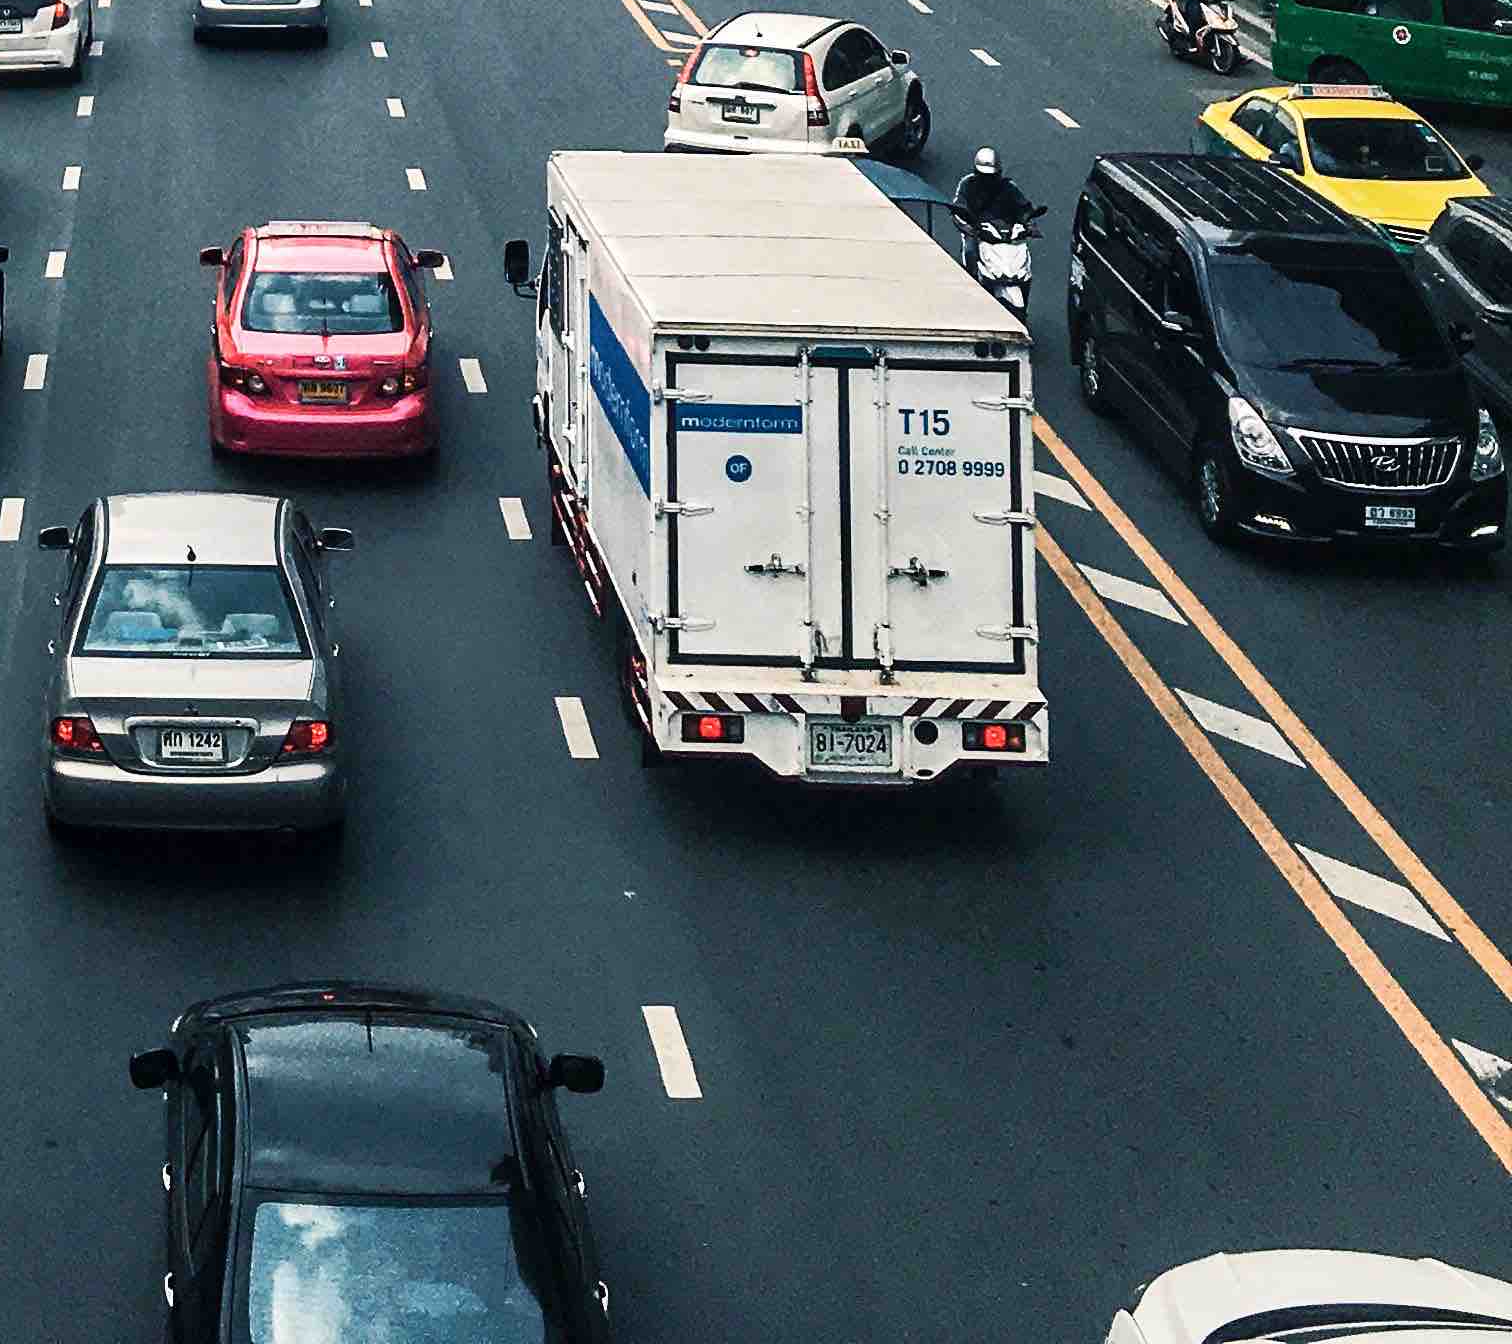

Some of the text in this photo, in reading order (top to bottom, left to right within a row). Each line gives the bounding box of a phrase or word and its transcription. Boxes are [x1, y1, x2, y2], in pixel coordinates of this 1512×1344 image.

[839, 140, 861, 149] TAXI
[681, 415, 798, 429] modernform
[898, 408, 950, 436] T15
[898, 445, 956, 456] Call Center
[730, 463, 747, 473] OF
[898, 459, 1005, 478] 0 2708 9999
[189, 733, 220, 748] 1242
[816, 733, 887, 754] 81-7024
